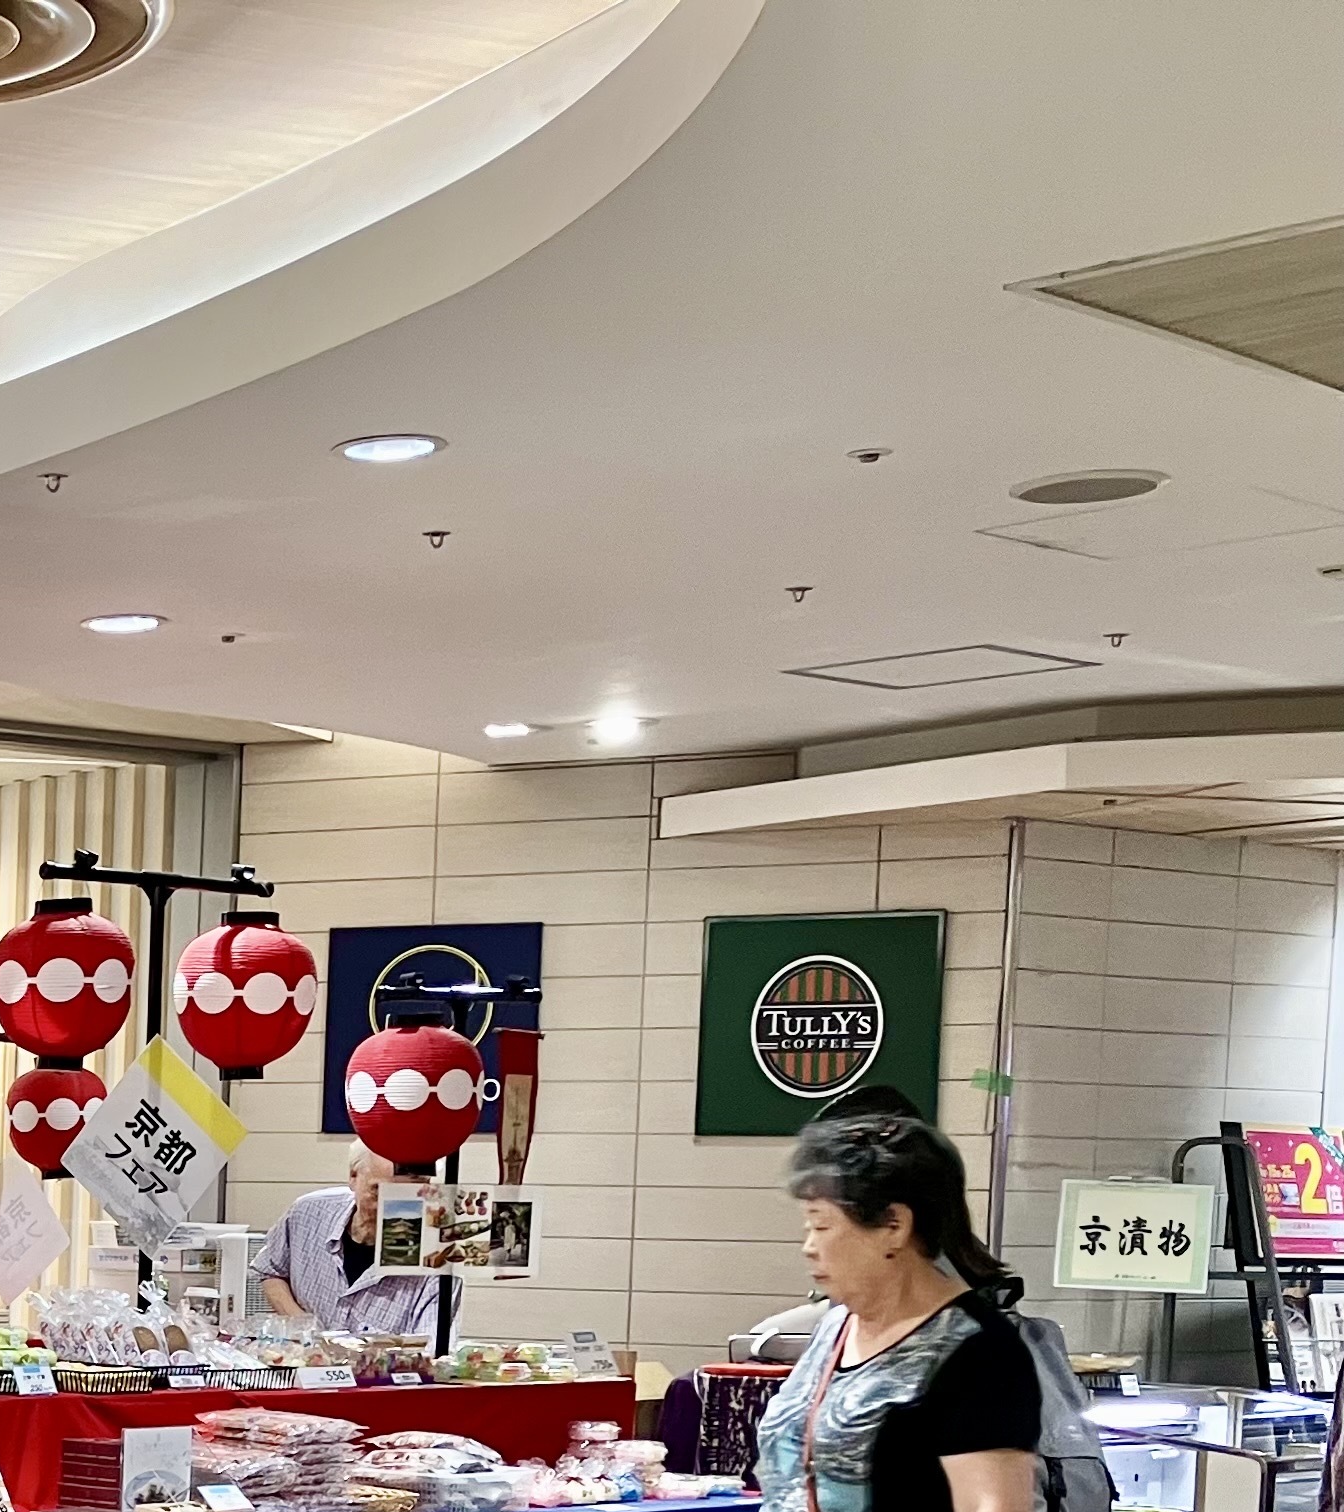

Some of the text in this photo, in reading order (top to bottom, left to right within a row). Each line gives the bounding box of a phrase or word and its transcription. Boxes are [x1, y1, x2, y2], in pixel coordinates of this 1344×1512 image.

[762, 1010, 872, 1037] TULLY'S
[781, 1038, 851, 1050] COFFEE
[124, 1098, 197, 1175] 京都
[104, 1132, 169, 1194] フェア
[1078, 1215, 1192, 1257] 京漬物
